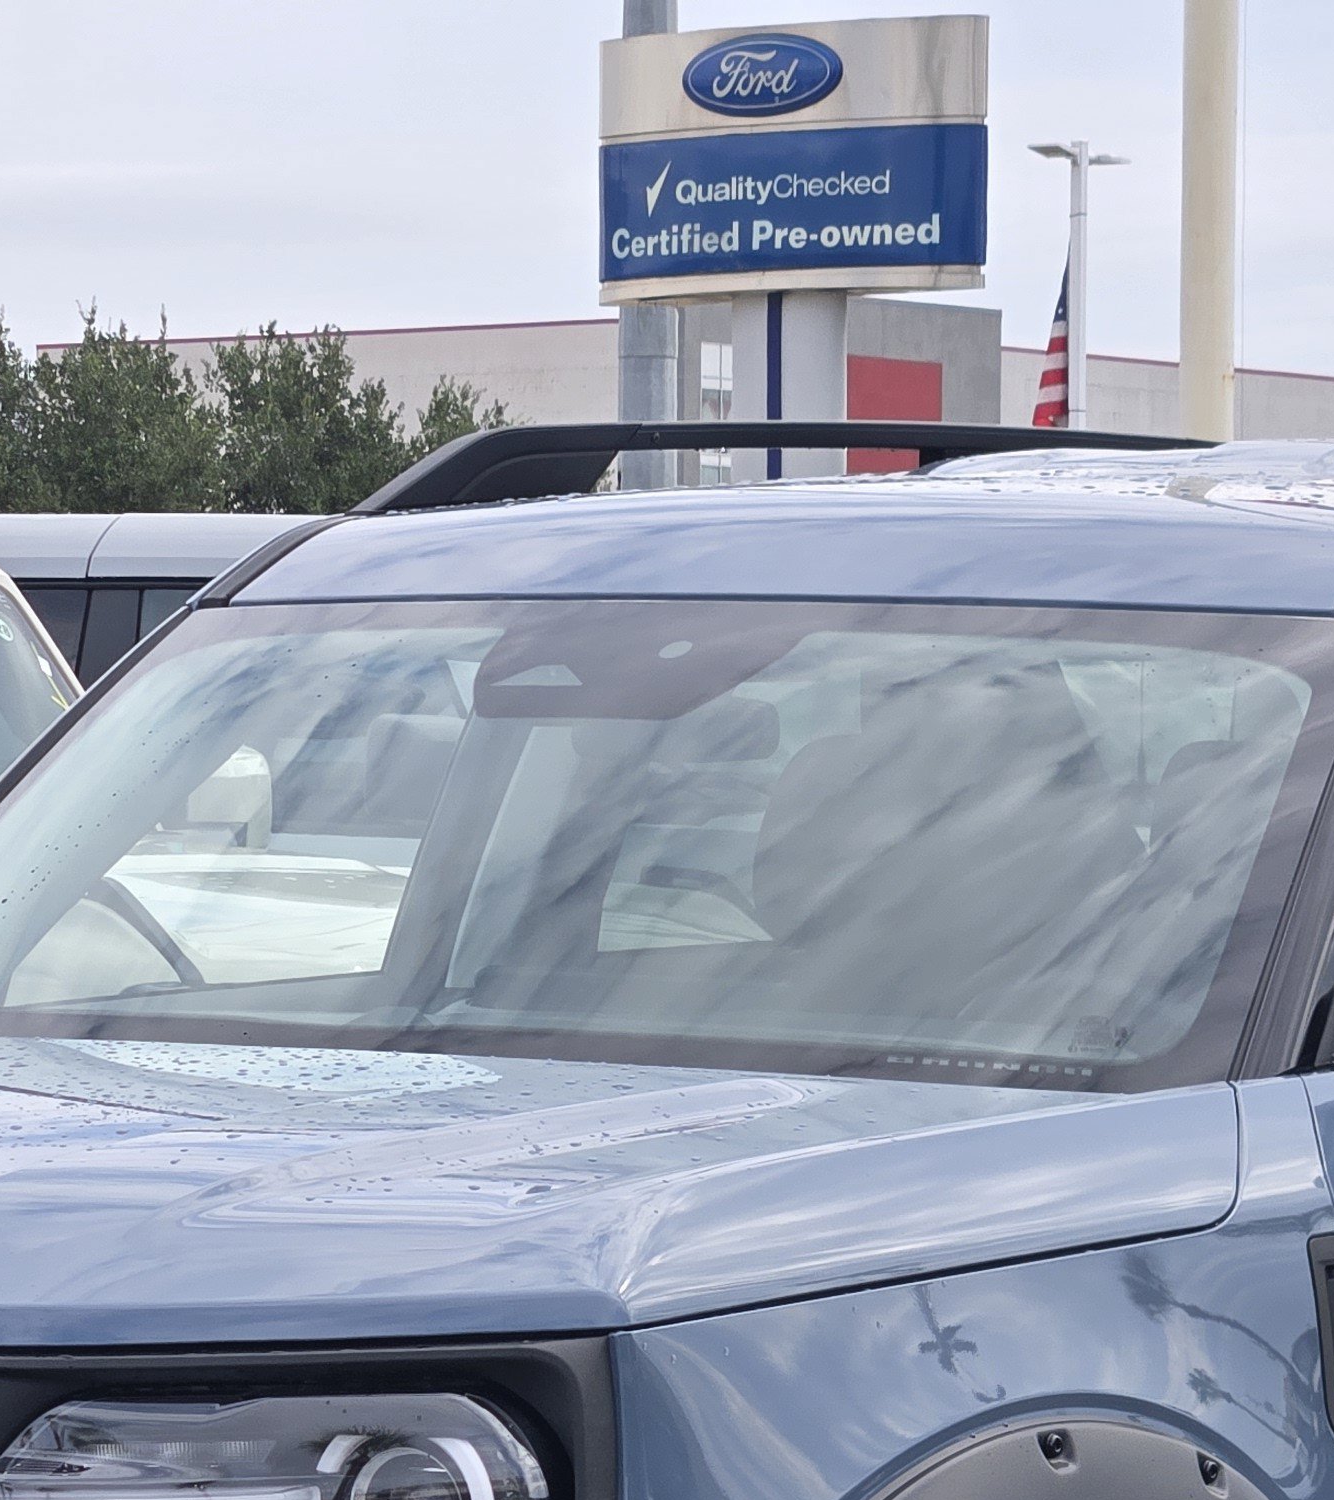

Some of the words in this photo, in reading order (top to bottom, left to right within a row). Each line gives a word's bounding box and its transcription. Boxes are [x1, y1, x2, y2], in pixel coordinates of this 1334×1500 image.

[712, 49, 799, 98] Ford
[612, 220, 740, 260] Certified
[751, 213, 941, 252] Pre-owned
